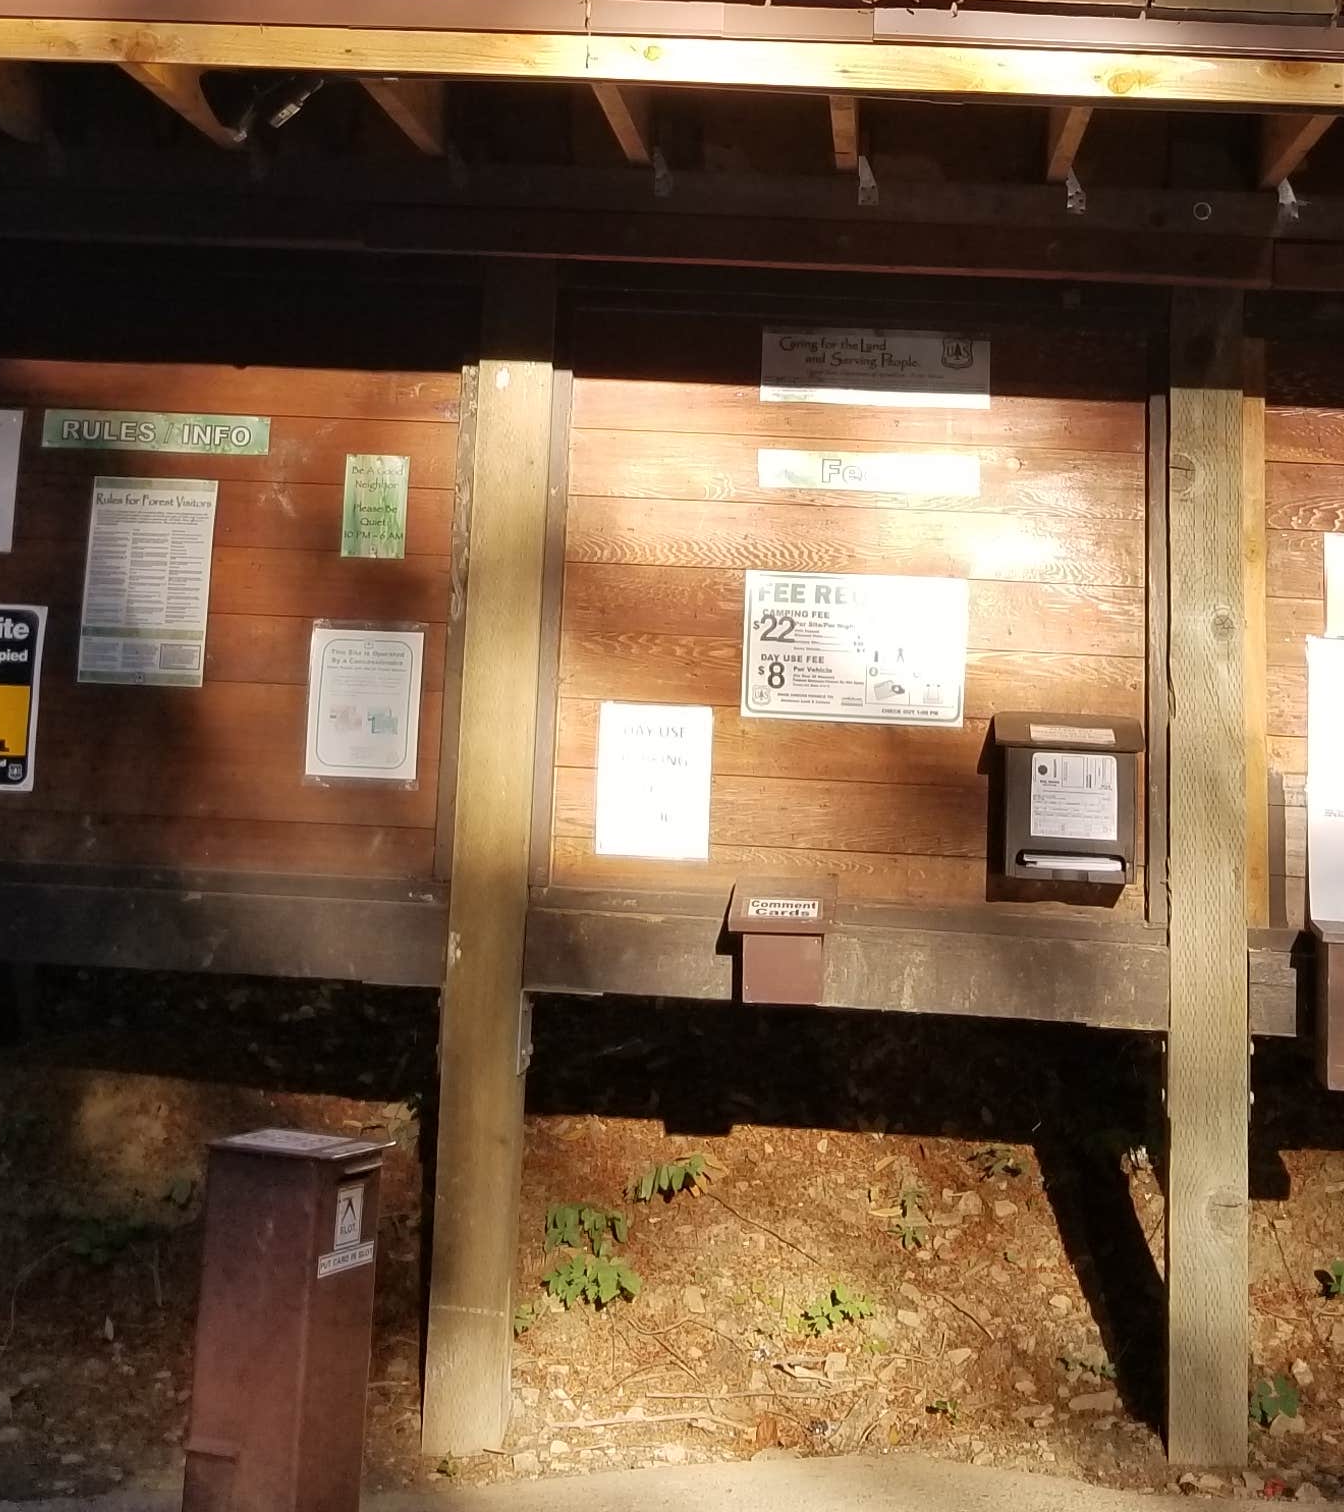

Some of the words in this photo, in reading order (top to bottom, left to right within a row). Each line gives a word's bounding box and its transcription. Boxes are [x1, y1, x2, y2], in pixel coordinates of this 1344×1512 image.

[780, 337, 818, 352] Caring
[821, 338, 837, 350] for
[841, 339, 860, 351] the
[860, 339, 886, 353] Land
[806, 354, 825, 364] and
[830, 352, 876, 368] Serving
[62, 419, 155, 443] RULES
[182, 424, 252, 446] INFO
[352, 466, 364, 474] Be
[356, 478, 399, 492] Neighbor
[96, 493, 122, 505] Rules
[126, 494, 140, 505] for
[142, 495, 174, 506] Forest
[177, 496, 211, 508] Visitors
[354, 501, 383, 513] Please
[385, 505, 397, 513] Be
[758, 582, 805, 603] FEE
[763, 609, 808, 618] CAMPING
[784, 654, 802, 662] USE
[806, 656, 824, 664] FEE
[660, 727, 687, 737] USE
